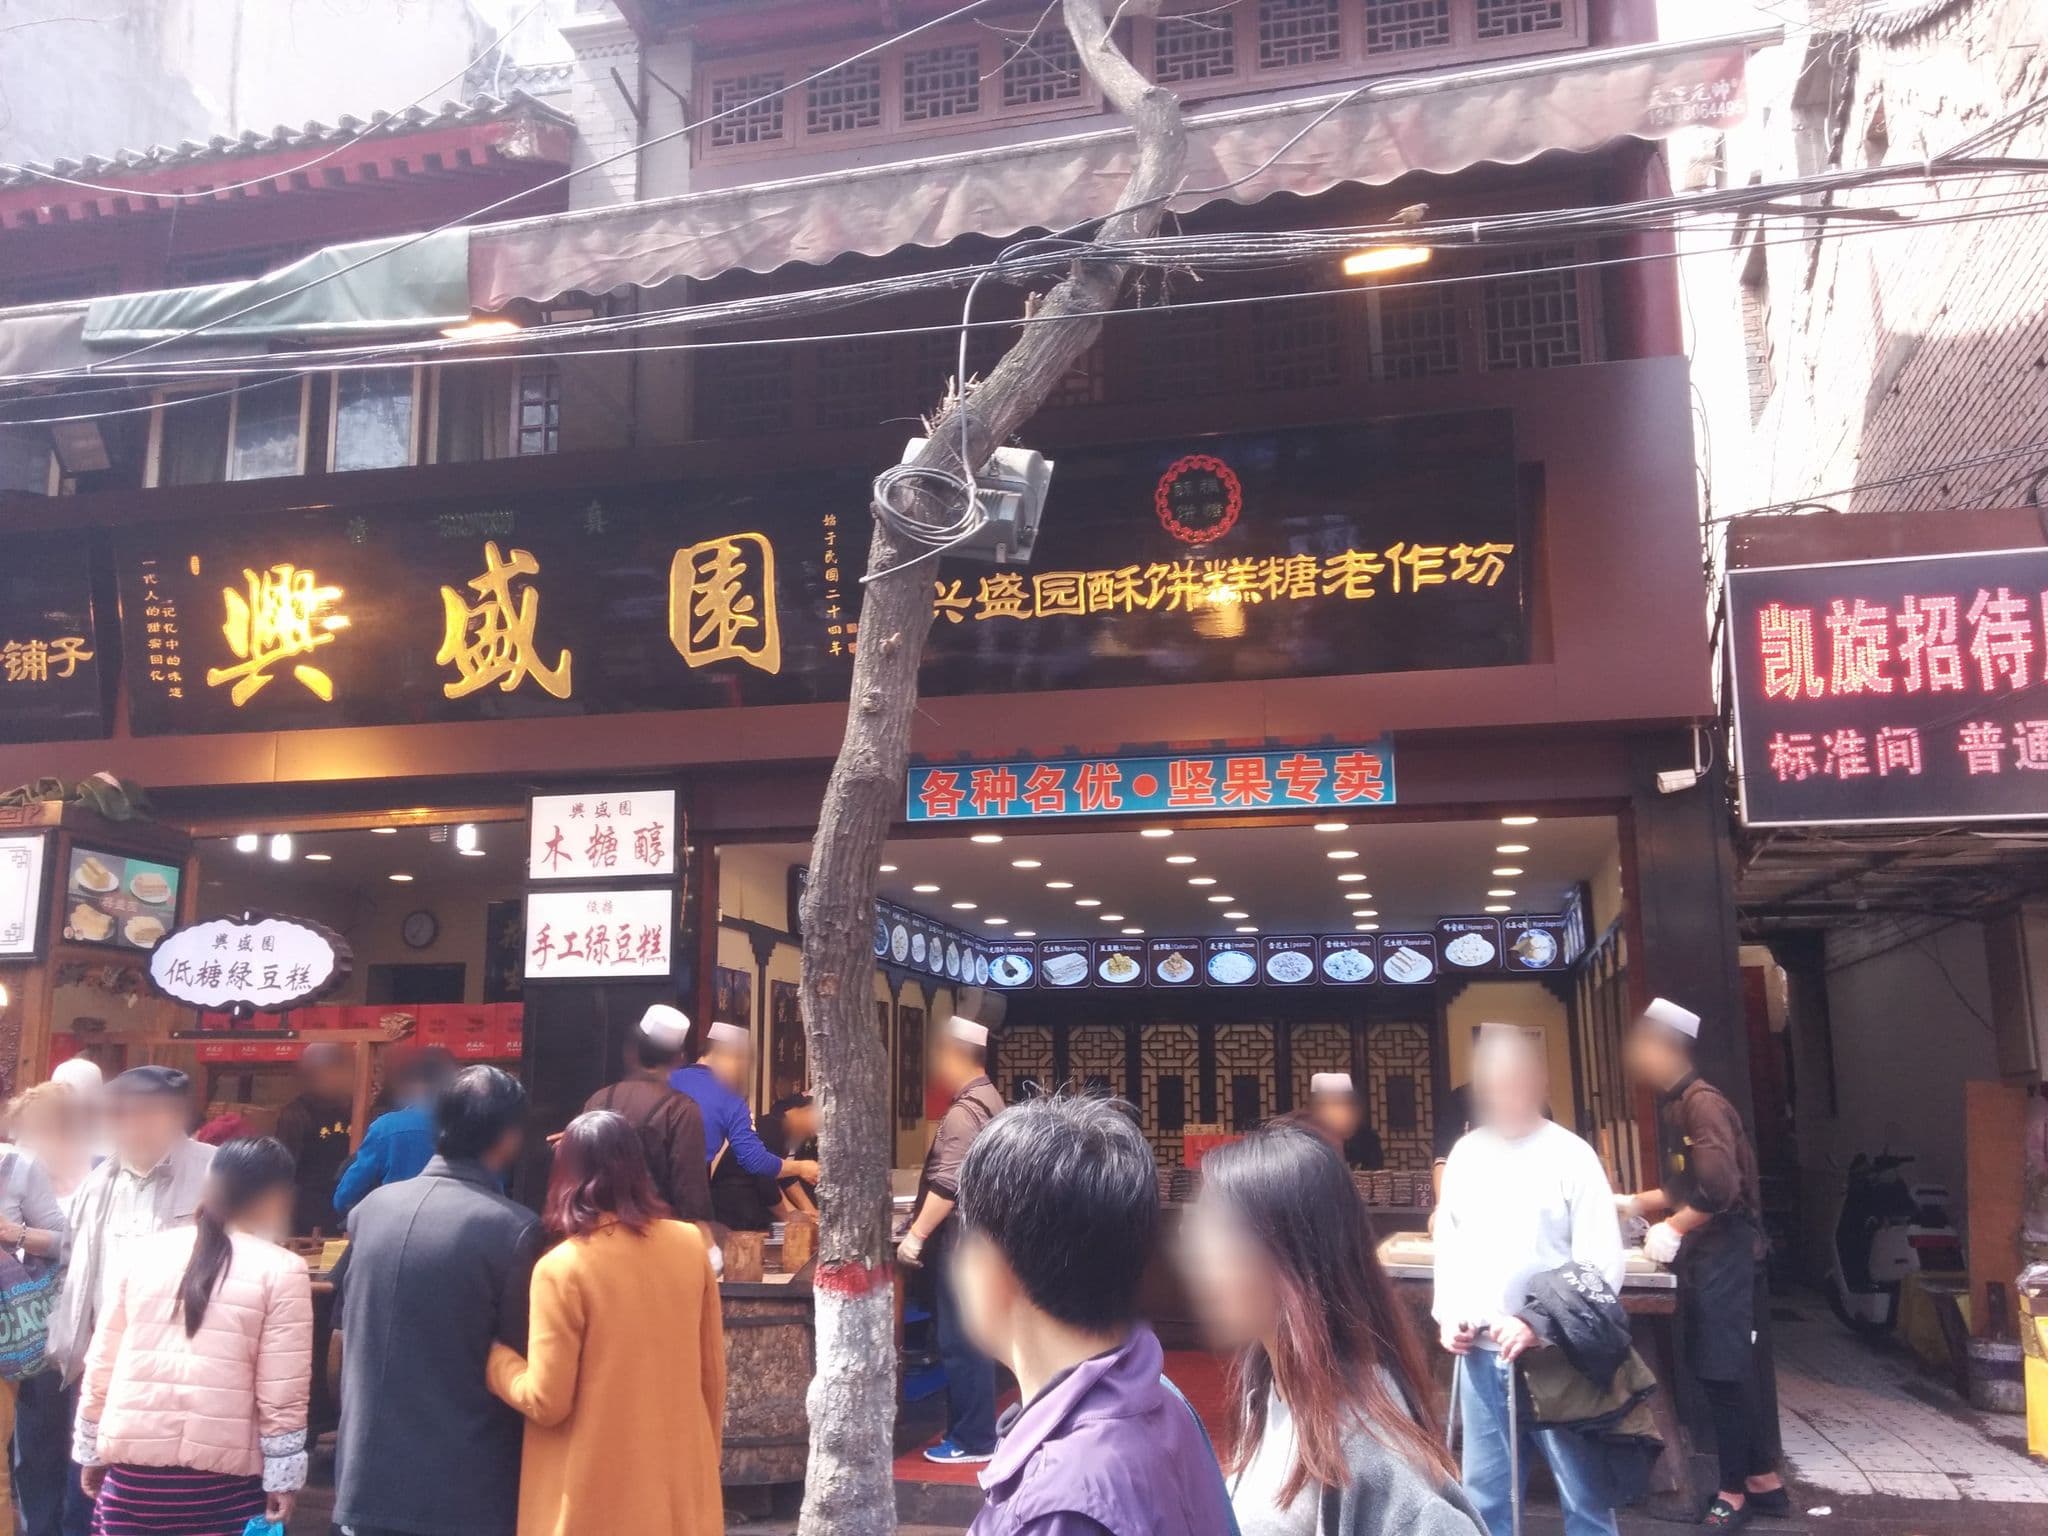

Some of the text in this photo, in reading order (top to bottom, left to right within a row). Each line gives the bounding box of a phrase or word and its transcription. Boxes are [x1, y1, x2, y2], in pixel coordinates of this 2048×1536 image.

[933, 541, 1514, 624] 兴盛园酥饼糕糖老作坊
[0, 637, 94, 682] 铺子
[1758, 587, 2048, 701] 凯旋招待
[1768, 720, 2048, 782] 标准间 普通
[541, 821, 665, 873] 木糖醇
